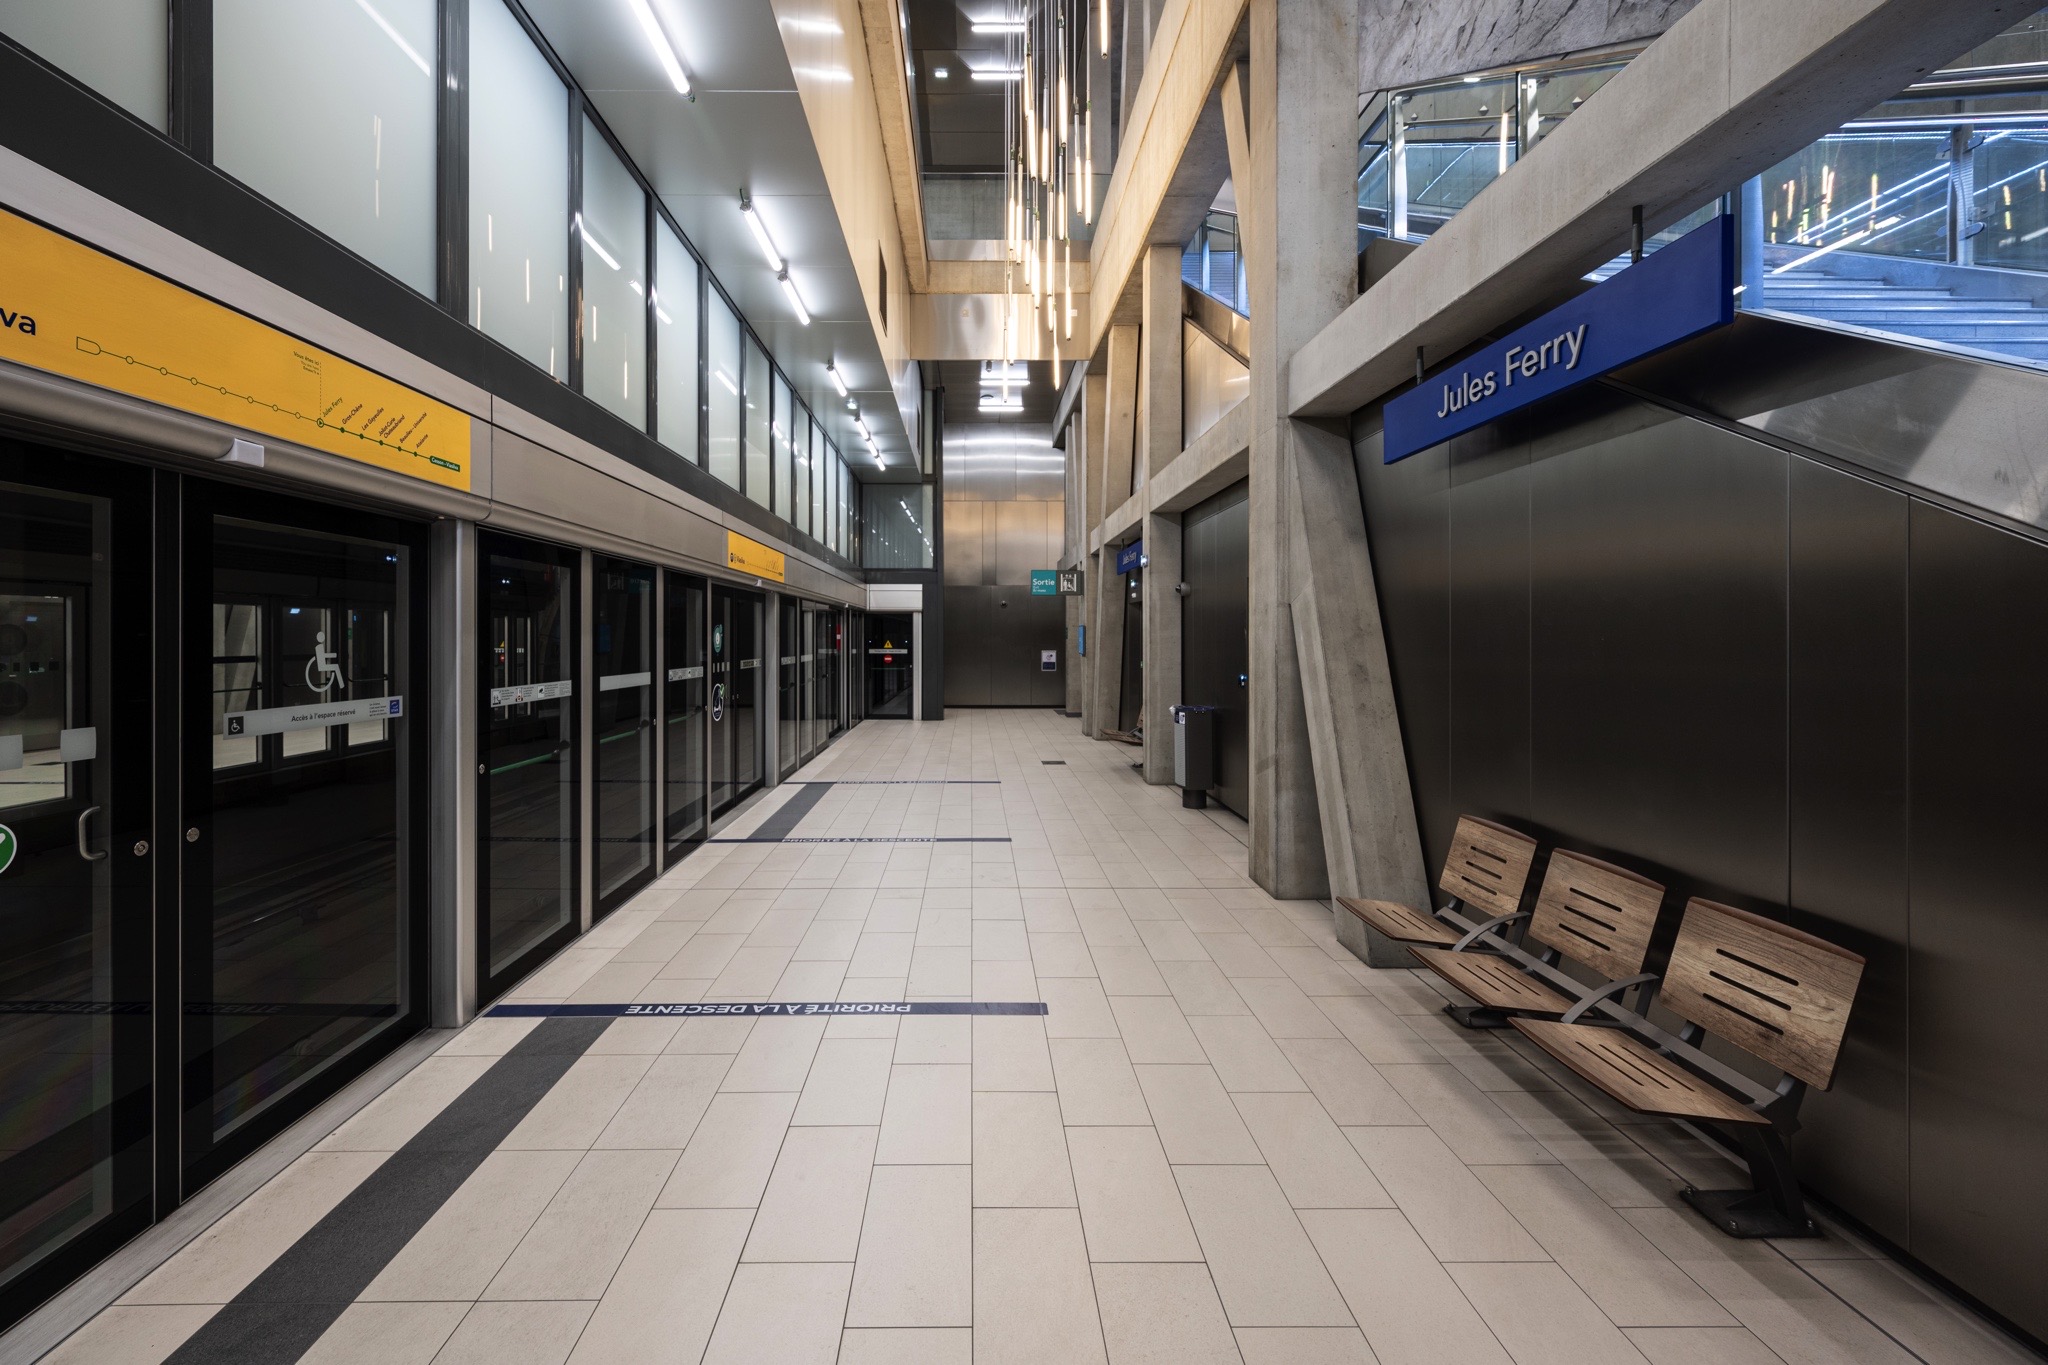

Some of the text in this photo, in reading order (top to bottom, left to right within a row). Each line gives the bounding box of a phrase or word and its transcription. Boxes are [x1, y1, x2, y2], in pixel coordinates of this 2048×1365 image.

[1437, 323, 1588, 419] Jules Ferry
[322, 397, 343, 418] Jules Ferry
[341, 403, 363, 425] Gros-Chêne
[361, 423, 369, 431] Les
[1032, 578, 1055, 586] Sortie
[291, 714, 308, 722] Accès
[314, 711, 336, 719] l'espace
[337, 708, 356, 717] réservé
[625, 1003, 912, 1015] PRIORITÉ À LA DESCENTE
